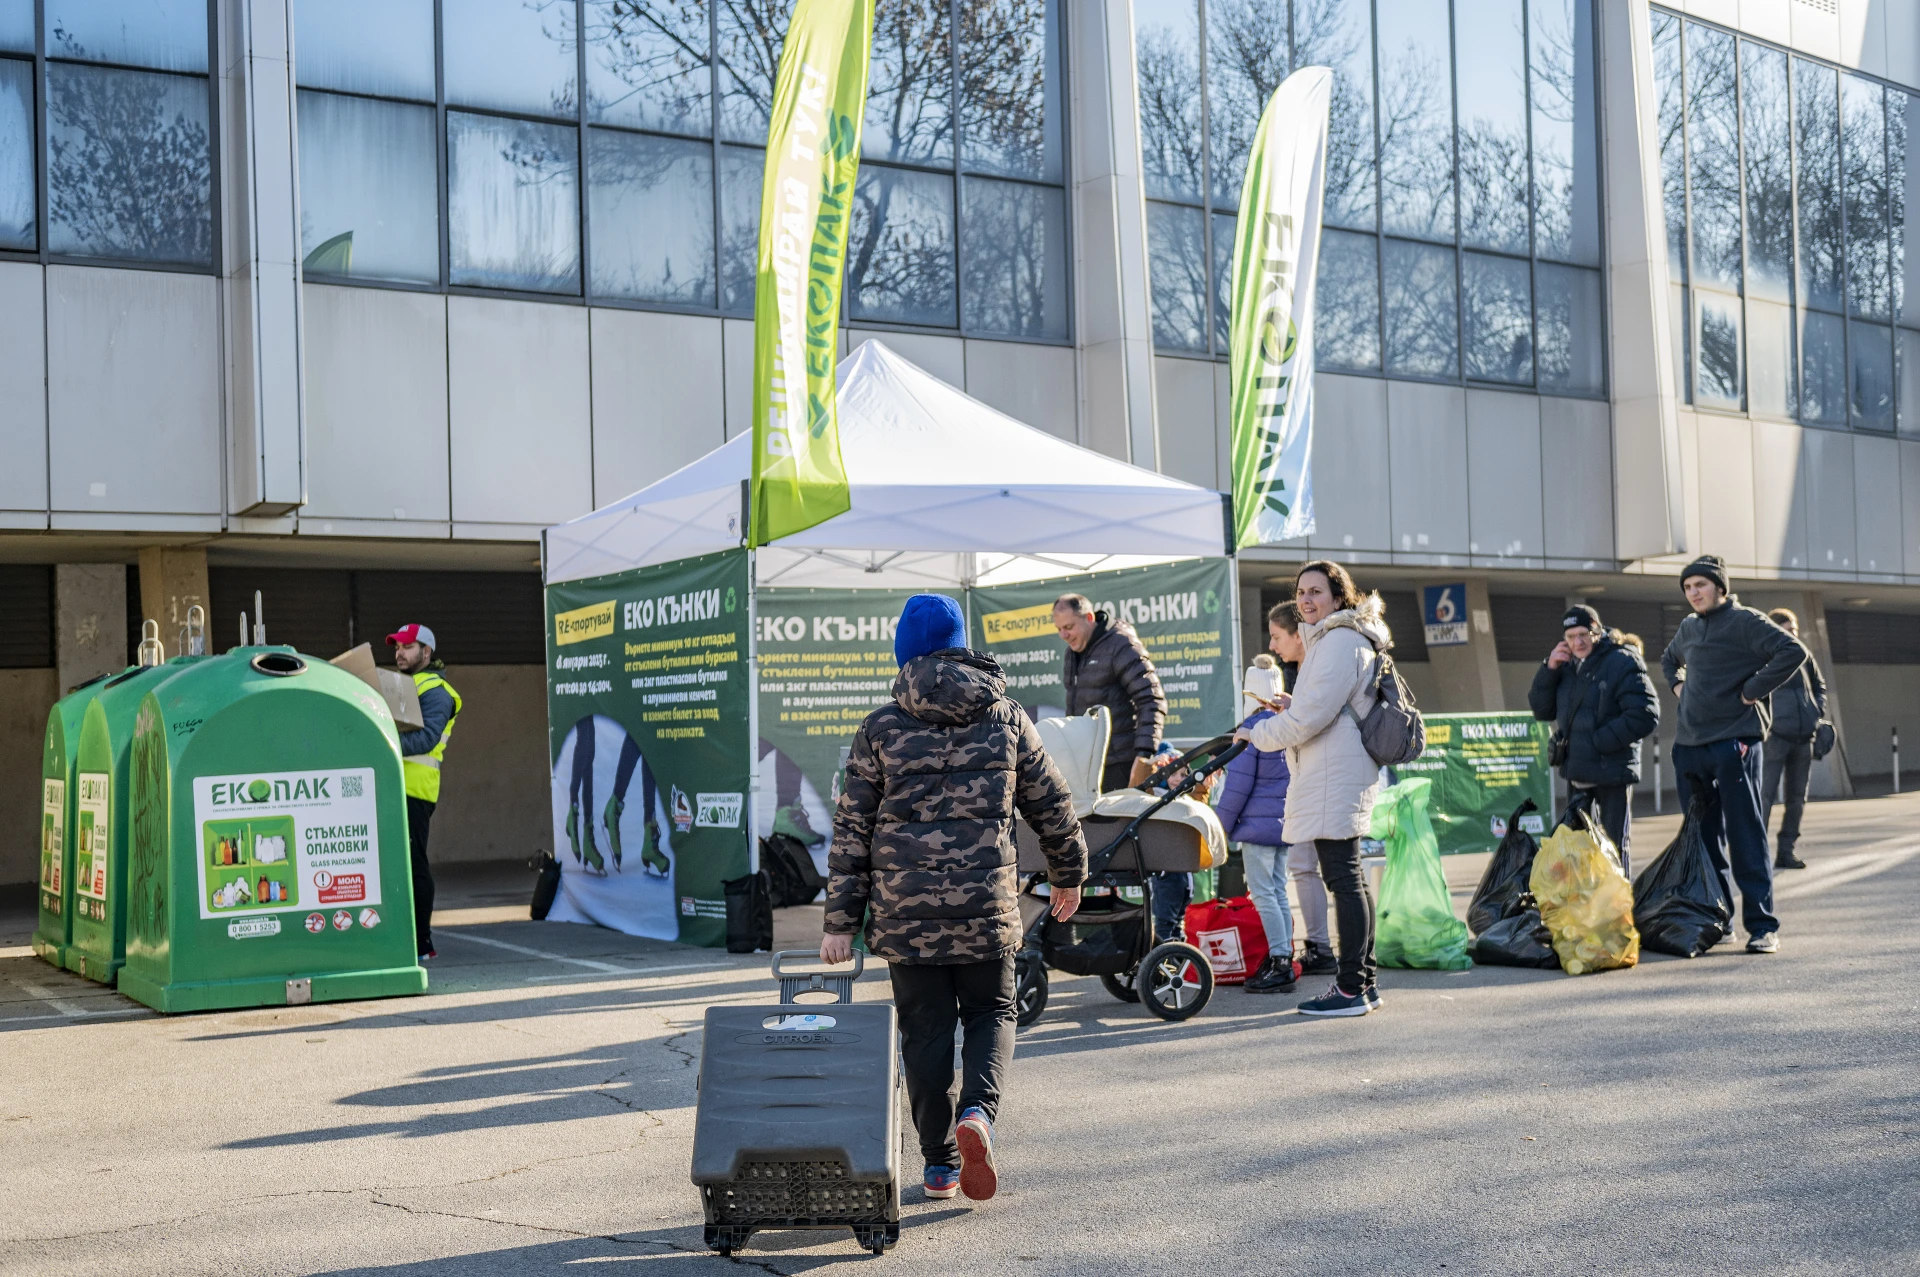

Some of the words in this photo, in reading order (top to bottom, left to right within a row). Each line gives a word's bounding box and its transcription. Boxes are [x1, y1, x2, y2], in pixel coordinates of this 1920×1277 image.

[790, 62, 827, 162] ТУК!
[806, 173, 848, 378] ЕКОПАК
[1255, 212, 1297, 517] ЕКОПАК
[623, 599, 654, 631] ЕКО
[657, 588, 720, 626] КЪНКИ
[1119, 591, 1198, 624] КЪНКИ
[1436, 587, 1455, 623] 6
[812, 616, 900, 641] КЪНК
[988, 614, 1055, 633] RE-спортува
[625, 642, 650, 657] Върнете
[651, 638, 683, 653] минимум
[684, 637, 691, 648] 10
[692, 636, 700, 647] кг
[701, 632, 736, 647] отпадъци
[1156, 634, 1165, 645] 10
[1166, 634, 1176, 644] кг
[1176, 630, 1220, 644] отпадъци
[624, 661, 632, 672] от
[632, 659, 661, 671] стъклени
[662, 655, 690, 671] бутилки
[691, 654, 704, 665] или
[705, 650, 738, 667] буркани
[757, 653, 799, 665] ърнете
[801, 652, 861, 664] минимум
[863, 652, 876, 662] 10
[877, 652, 891, 662] кг
[1165, 649, 1183, 660] или
[1183, 646, 1222, 661] буркани
[631, 678, 644, 688] или
[655, 673, 697, 686] пластмасови
[698, 668, 728, 686] бутилки
[761, 667, 820, 678] стъклени
[822, 664, 874, 679] бутилки
[1175, 662, 1213, 679] бутилки
[760, 682, 784, 692] или
[808, 681, 887, 692] пластмасови
[1018, 675, 1029, 689] до
[1163, 681, 1199, 693] кенчета
[642, 694, 647, 705] и
[647, 692, 688, 707] алуминиеви
[689, 689, 717, 701] кенчета
[782, 697, 791, 707] и
[792, 695, 869, 708] алуминиеви
[1179, 698, 1201, 709] вход
[642, 712, 648, 722] и
[648, 710, 672, 722] вземете
[672, 706, 693, 720] билет
[693, 709, 702, 719] за
[702, 707, 720, 721] вход
[780, 711, 789, 721] и
[790, 710, 840, 721] вземете
[841, 708, 872, 720] биле
[656, 728, 665, 738] на
[806, 726, 823, 735] на
[1461, 723, 1485, 739] ЕКО
[1485, 722, 1528, 739] КЪНКИ
[211, 777, 332, 806] ЕКОПАК
[699, 805, 737, 825] ЕКОПАК
[305, 824, 368, 840] СТЪКЛЕНИ
[306, 840, 369, 856] ОПАКОВКИ
[311, 860, 330, 868] GLASS
[332, 857, 366, 866] PACKAGING
[232, 925, 237, 933] 0
[239, 924, 252, 932] 800
[260, 922, 276, 930] 5253
[762, 1033, 835, 1044] CITROËN
